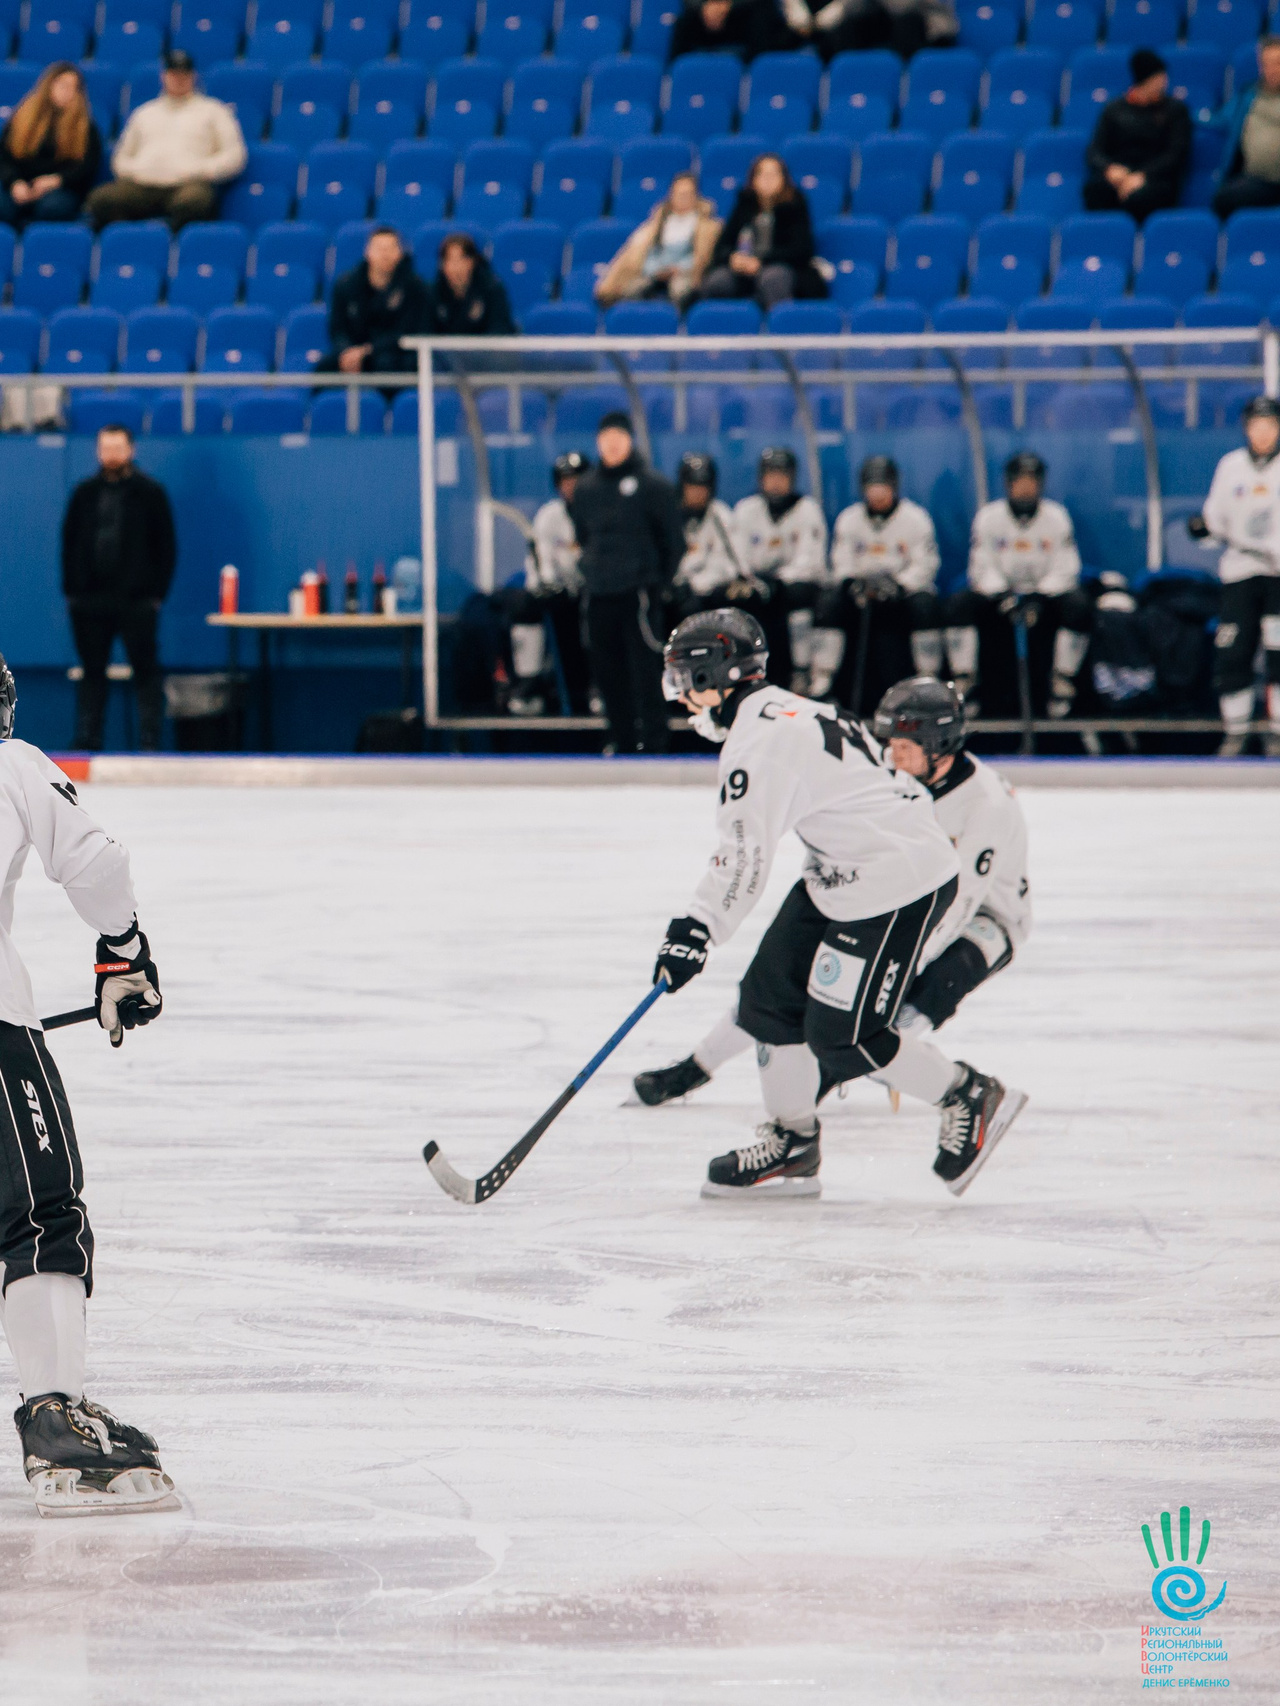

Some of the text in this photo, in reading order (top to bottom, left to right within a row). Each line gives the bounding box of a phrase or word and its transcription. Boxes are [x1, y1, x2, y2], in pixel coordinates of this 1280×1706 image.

[975, 847, 995, 876] 6
[658, 943, 707, 964] CCM
[107, 963, 130, 971] CCM
[20, 1079, 54, 1154] STEX
